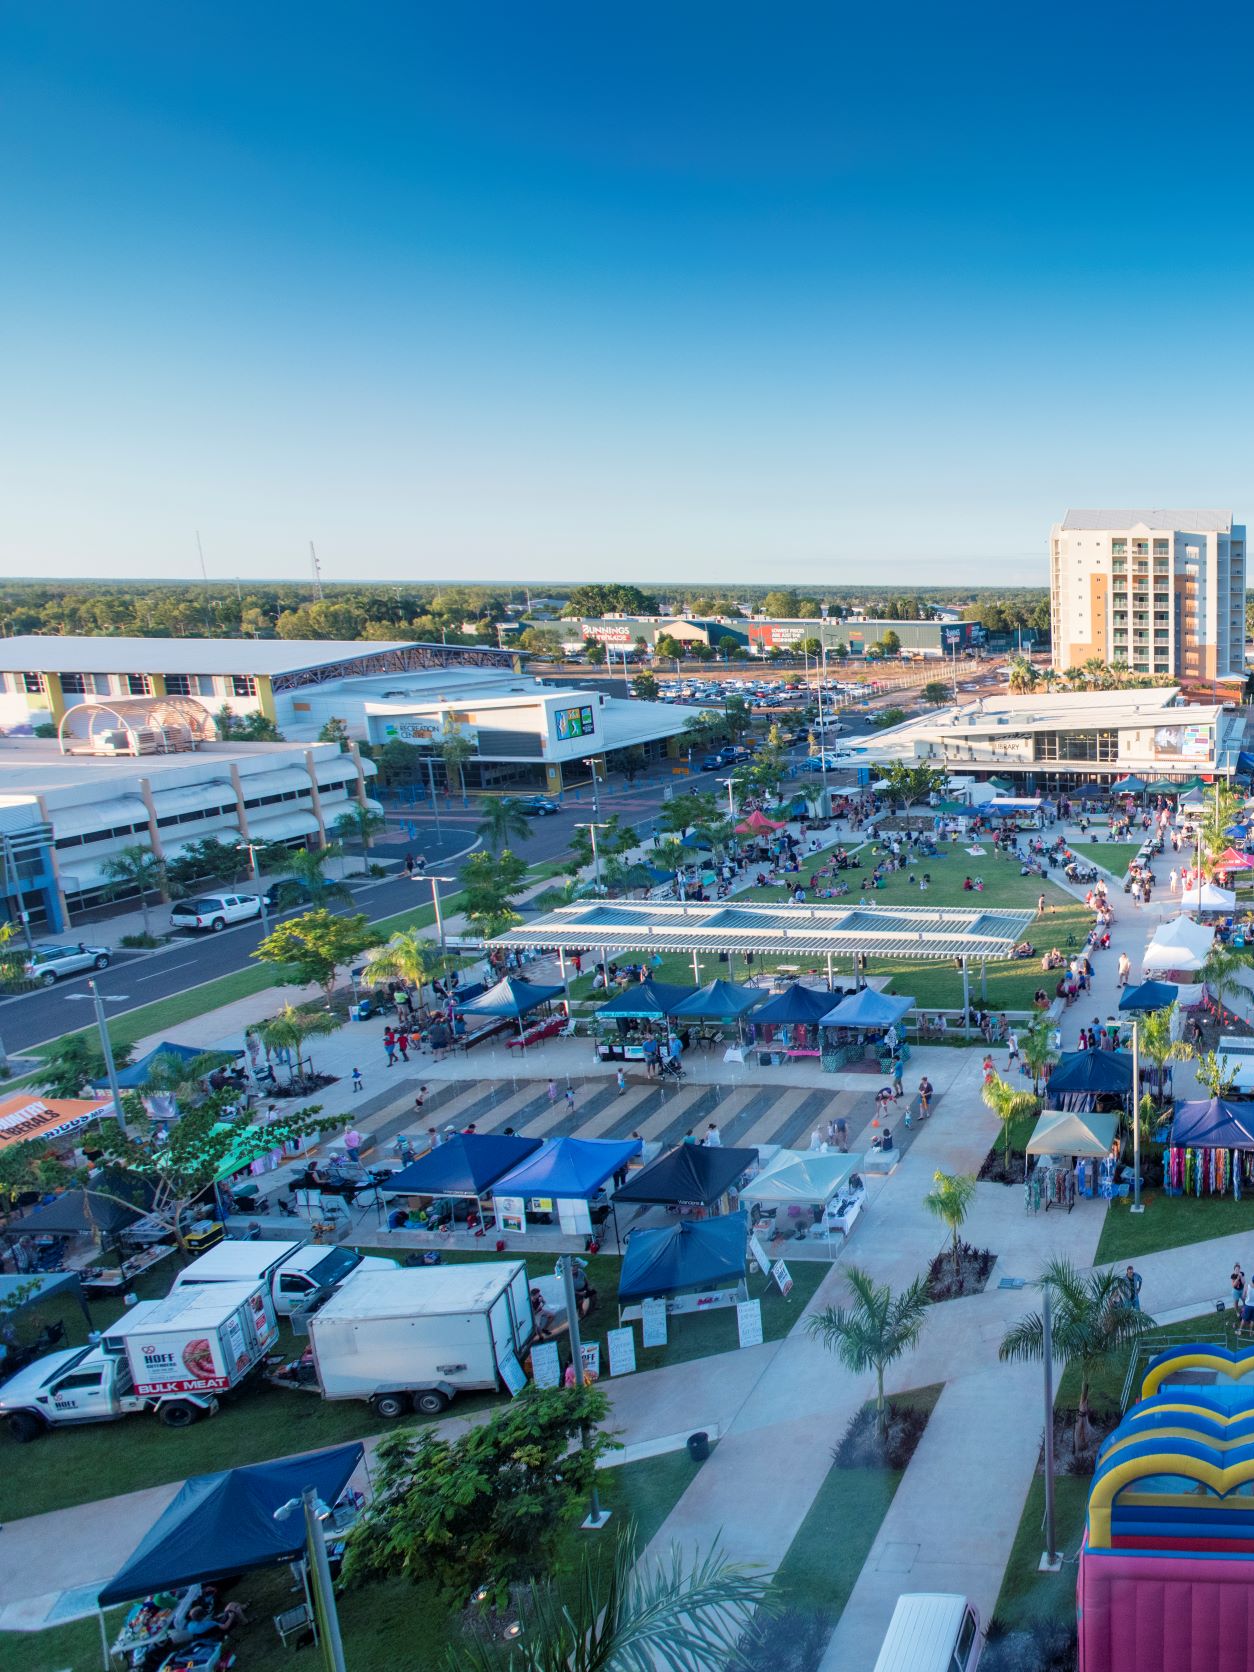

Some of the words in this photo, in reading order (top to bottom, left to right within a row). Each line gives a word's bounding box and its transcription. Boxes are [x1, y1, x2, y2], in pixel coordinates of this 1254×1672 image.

[582, 624, 630, 635] BUNNINGS
[400, 725, 440, 733] RECREATION
[995, 742, 1020, 751] LIBRARY
[144, 1352, 174, 1364] HOFF
[138, 1382, 179, 1395] BULK
[183, 1378, 226, 1392] MEAT
